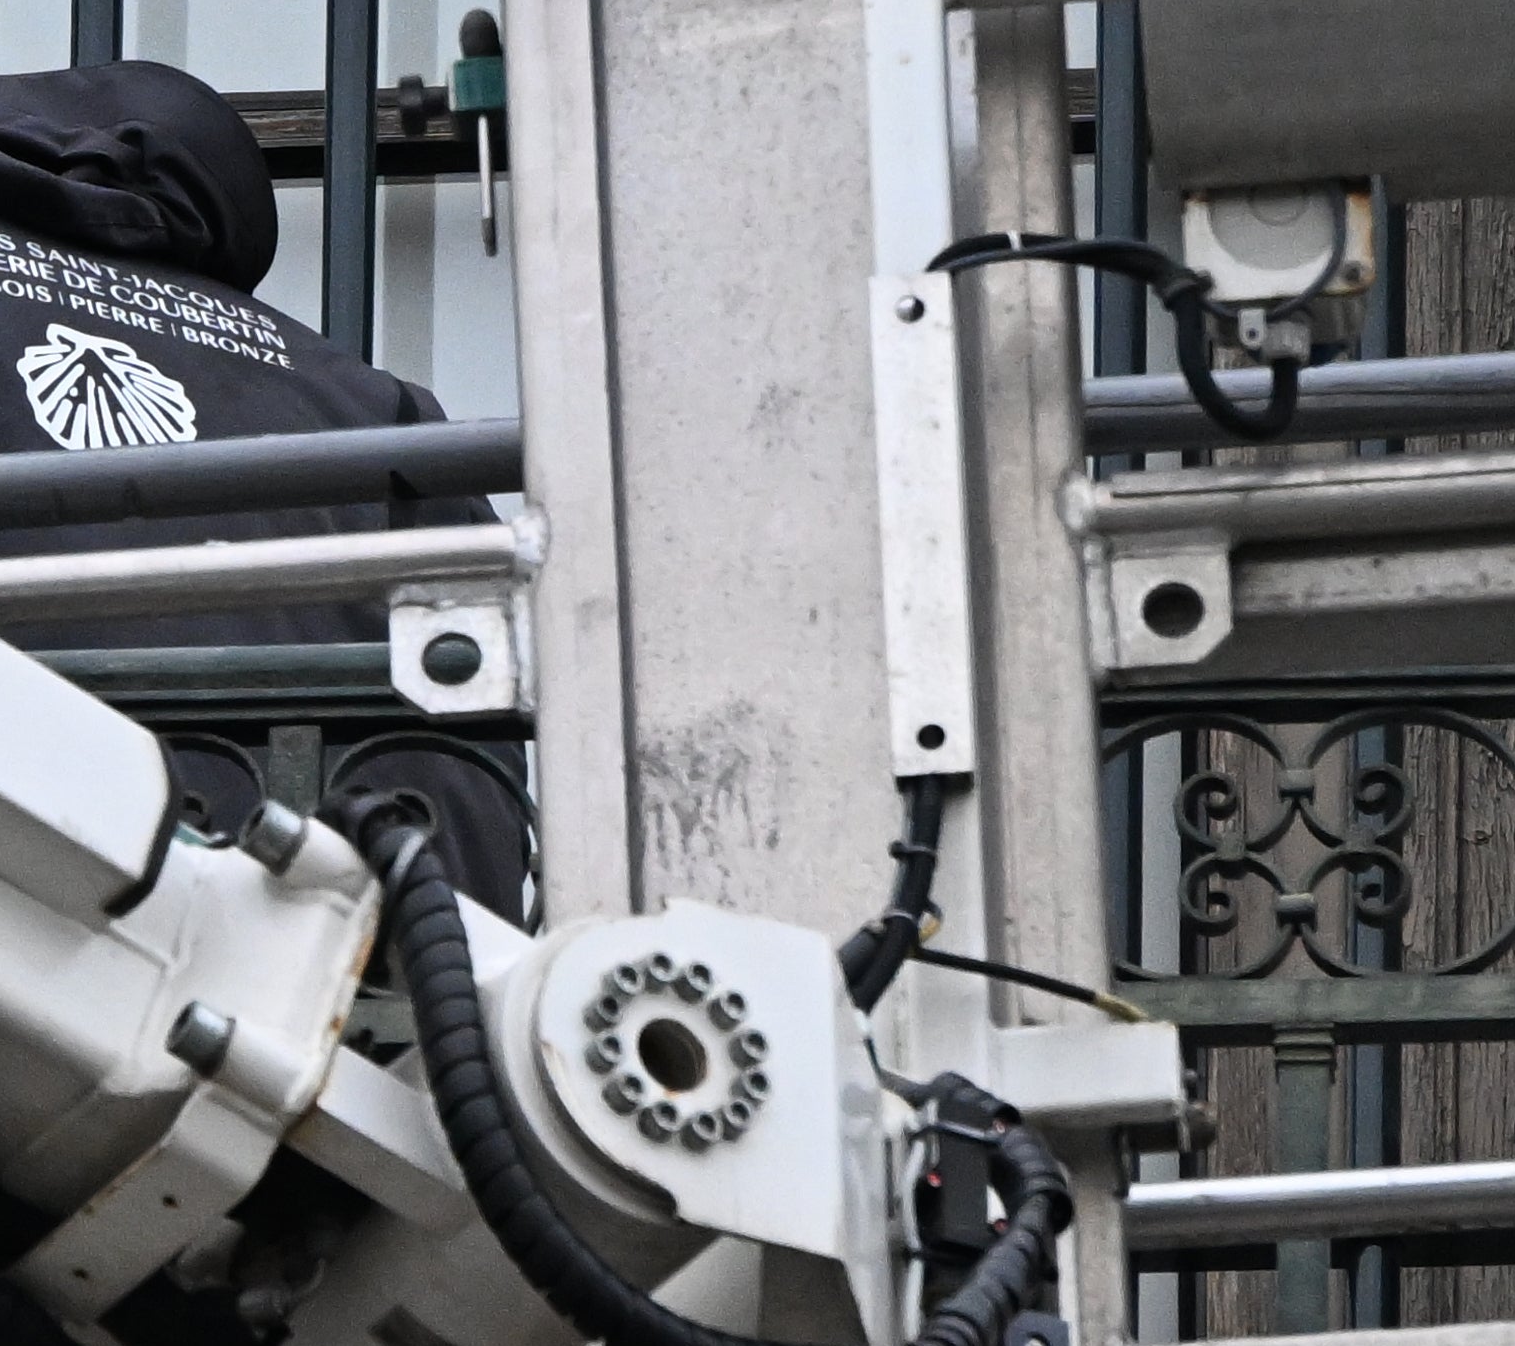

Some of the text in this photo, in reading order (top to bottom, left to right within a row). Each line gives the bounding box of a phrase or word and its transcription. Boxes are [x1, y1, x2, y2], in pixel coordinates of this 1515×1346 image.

[28, 240, 277, 331] SAINT-JACQUES
[63, 270, 102, 296] DE
[110, 284, 286, 350] COUBERTIN
[70, 295, 164, 335] PIERRE
[183, 325, 293, 371] BRONZE
